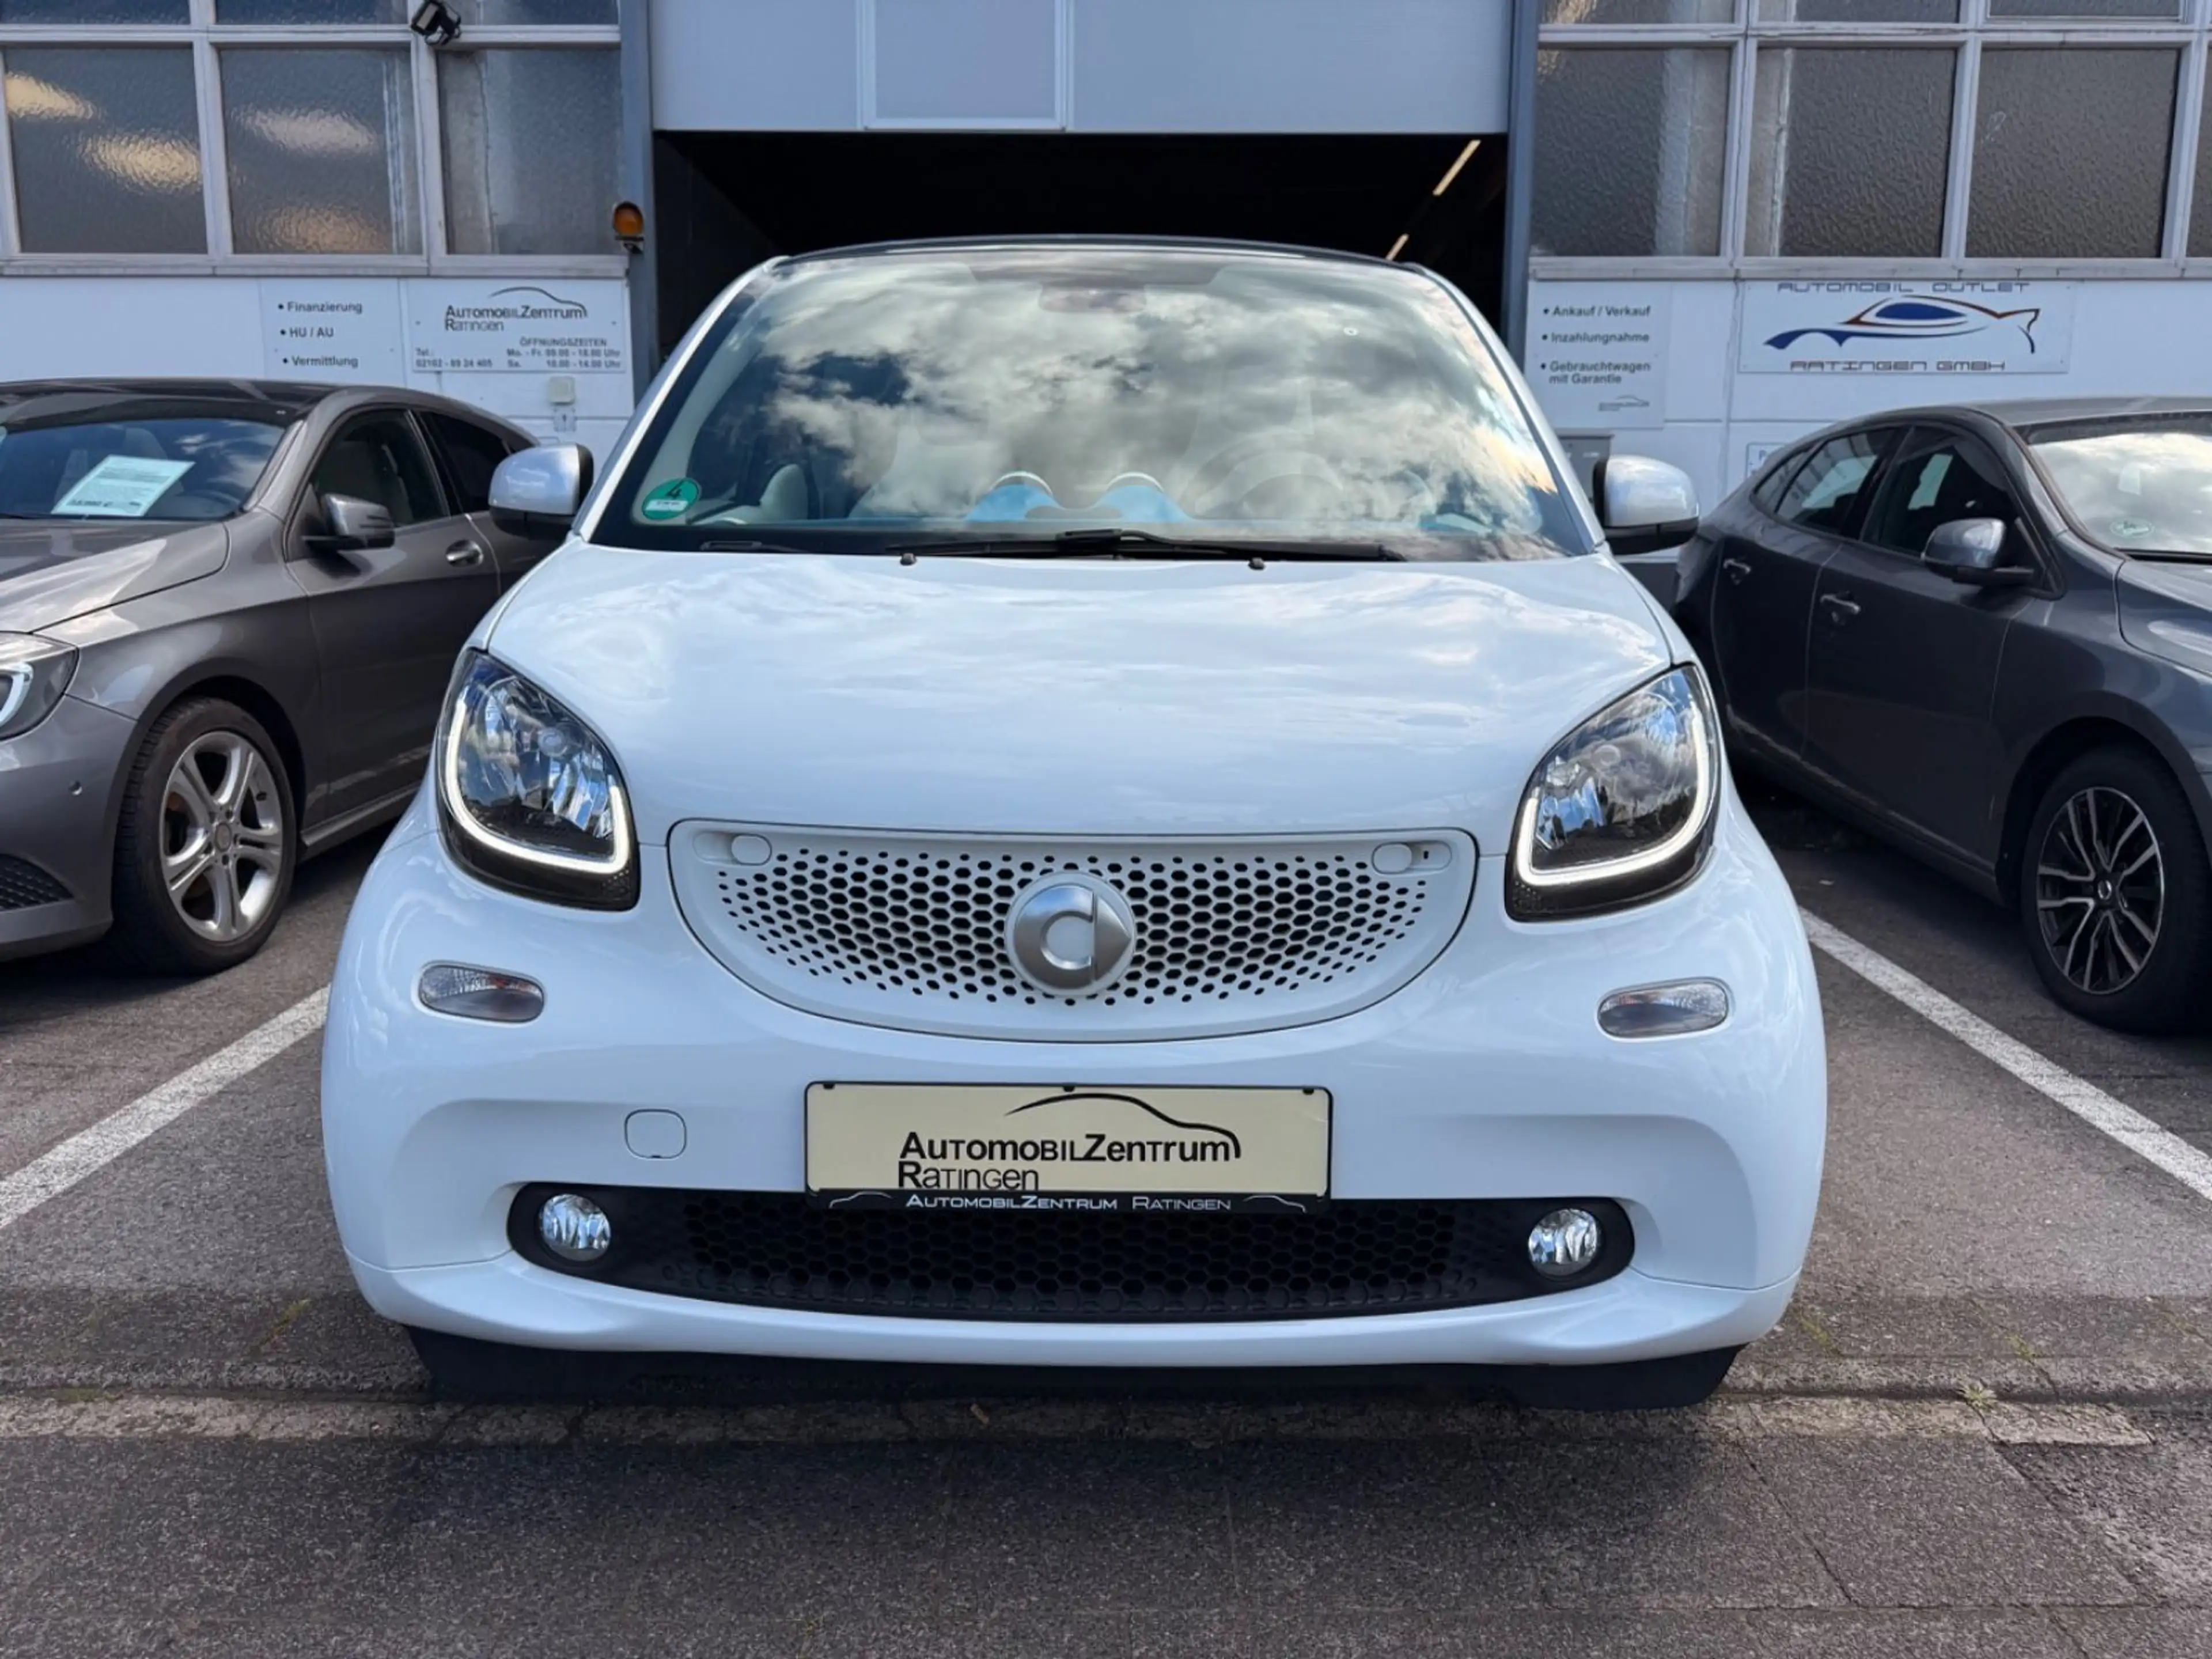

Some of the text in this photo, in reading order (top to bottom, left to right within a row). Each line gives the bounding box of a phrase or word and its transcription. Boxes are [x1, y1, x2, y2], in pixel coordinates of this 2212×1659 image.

[1778, 282, 2030, 293] AUTOMOBIL OUTLET
[287, 301, 363, 314] Finanzierung
[1552, 305, 1596, 316] Ankauf
[1605, 305, 1651, 317] Verkauf
[289, 327, 306, 338] HU
[316, 327, 334, 338] AU
[1551, 332, 1650, 346] Inzahlungnahme
[291, 355, 358, 369] Vermittlung
[1550, 360, 1651, 373] Gebrauchtwagen
[1790, 361, 1927, 371] RATINGEN
[1549, 373, 1622, 384] mit Garantie
[898, 1160, 1039, 1190] Ratingen
